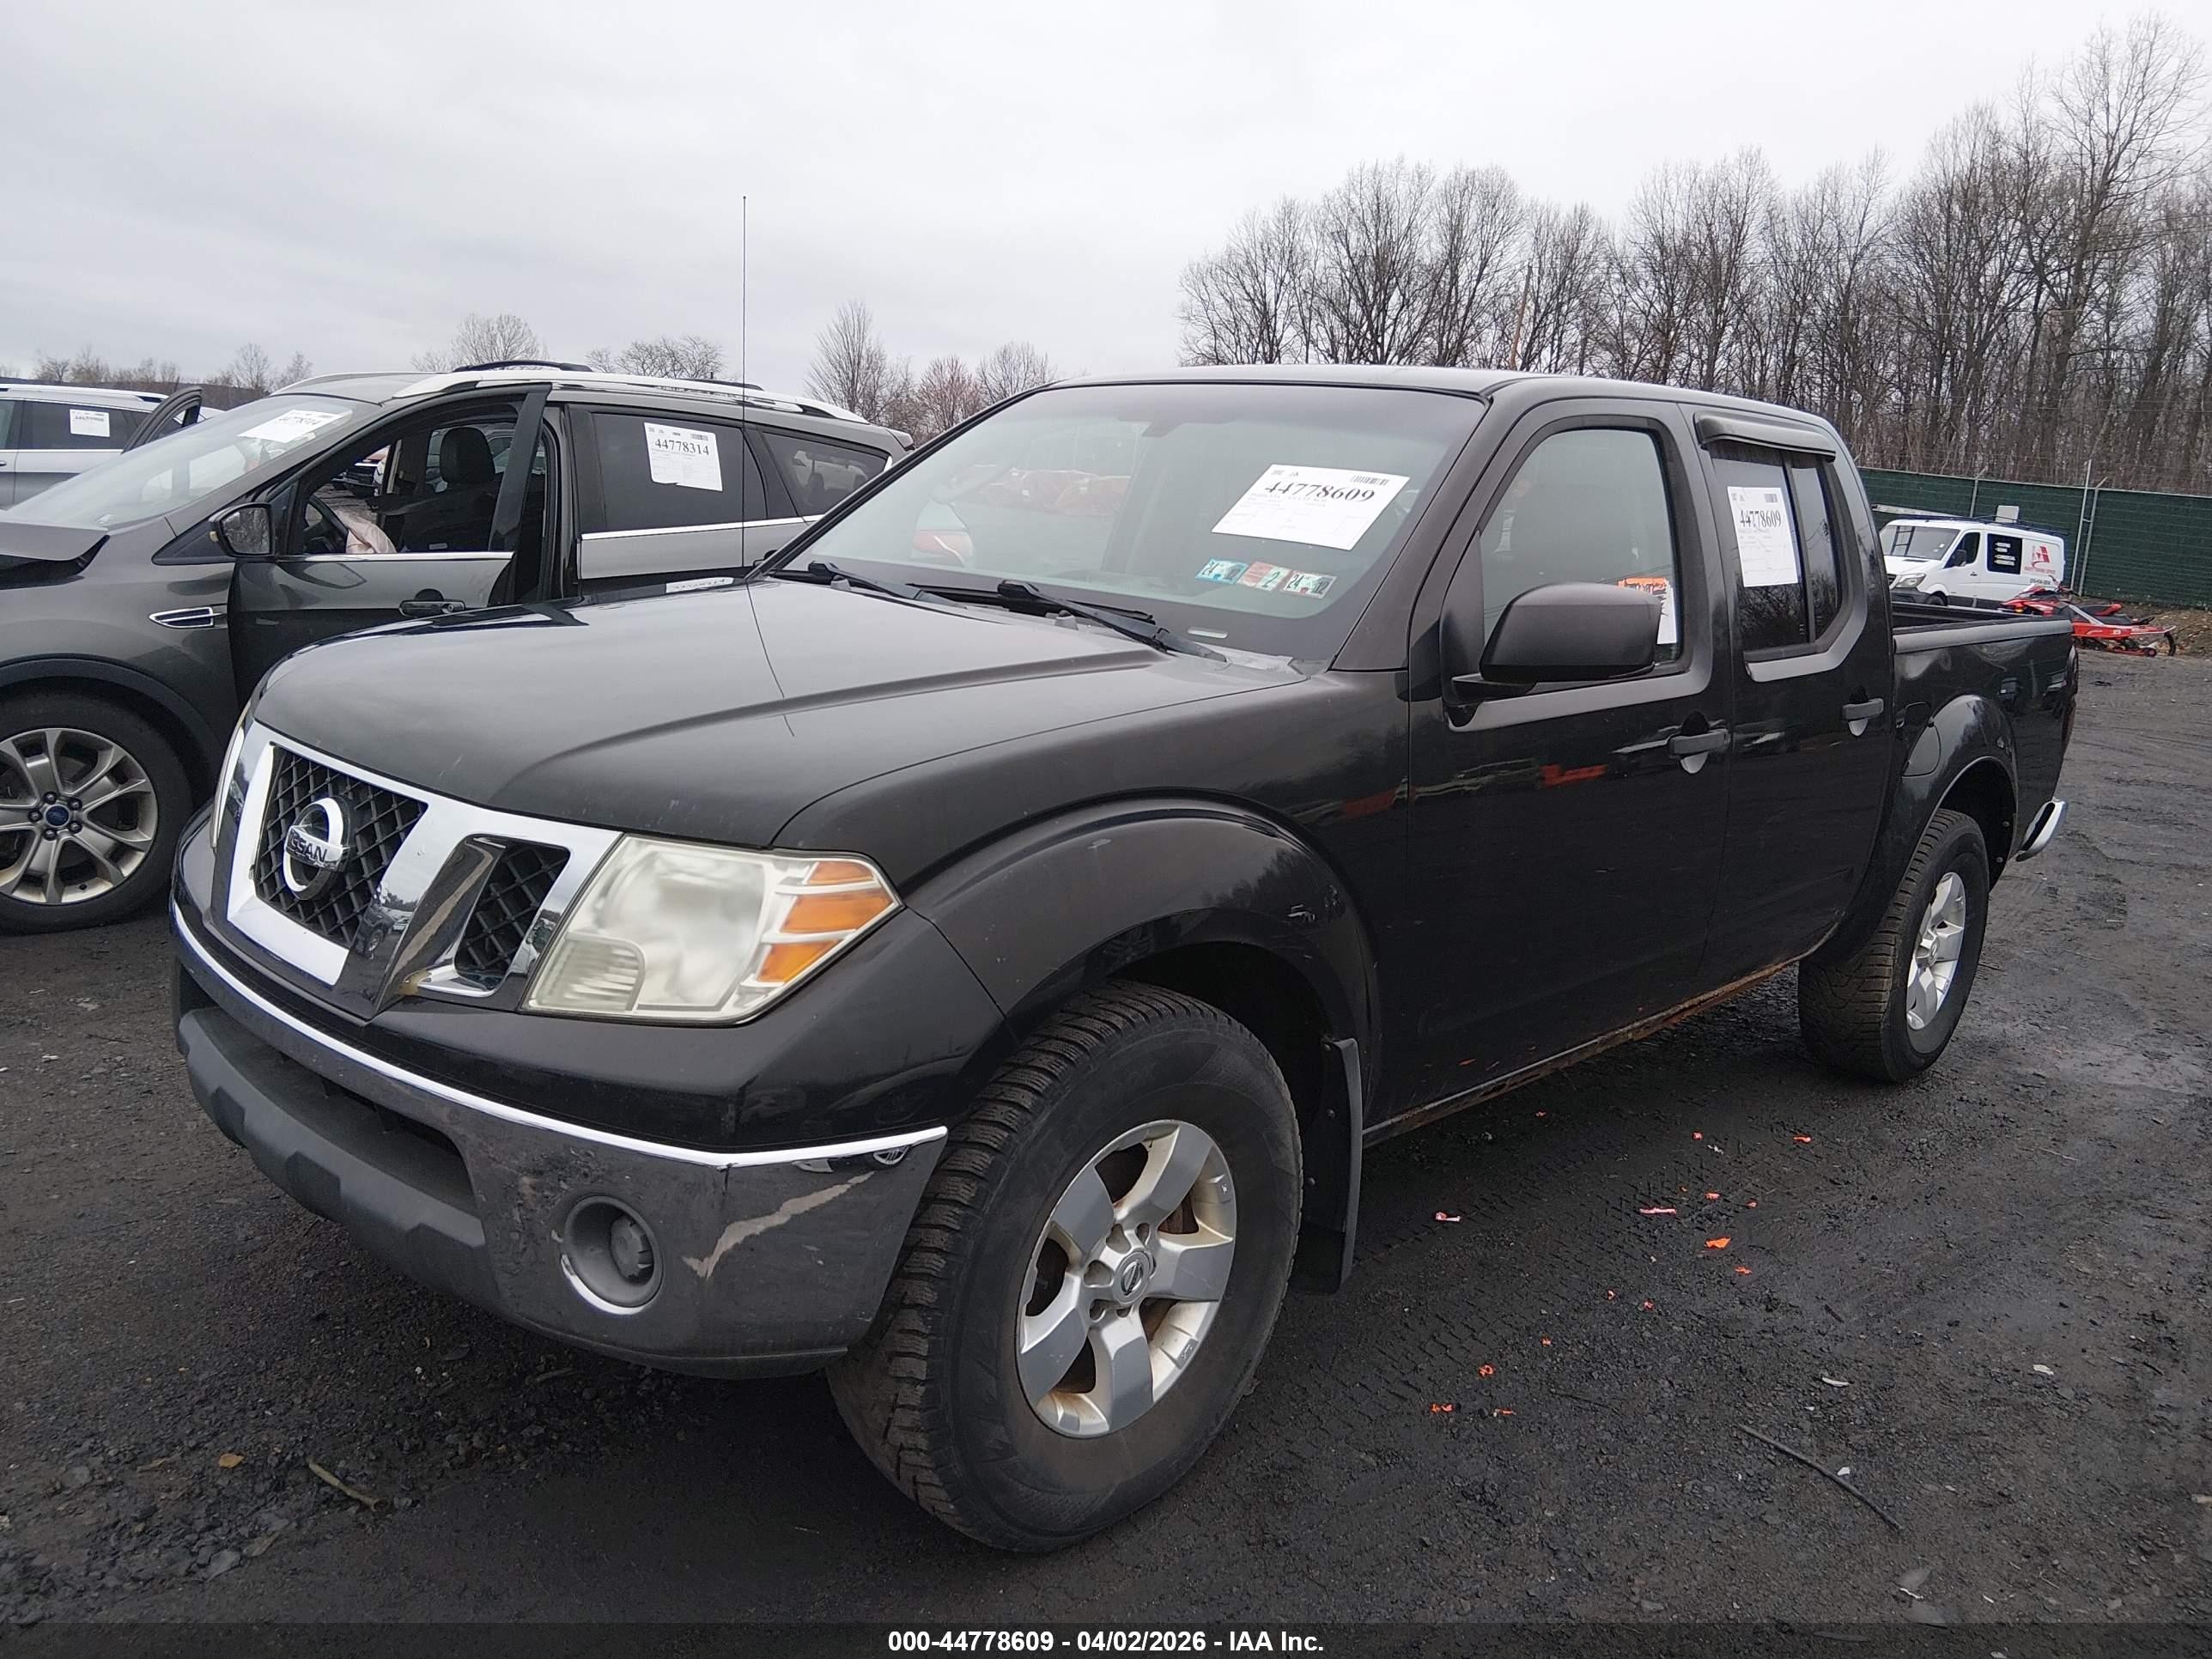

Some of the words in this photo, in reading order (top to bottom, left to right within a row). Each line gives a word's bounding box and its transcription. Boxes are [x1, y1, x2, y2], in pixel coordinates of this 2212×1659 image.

[654, 438, 709, 456] 44778314
[1264, 481, 1375, 502] 44778609
[1740, 509, 1782, 528] 44778609
[1286, 574, 1305, 590] 24
